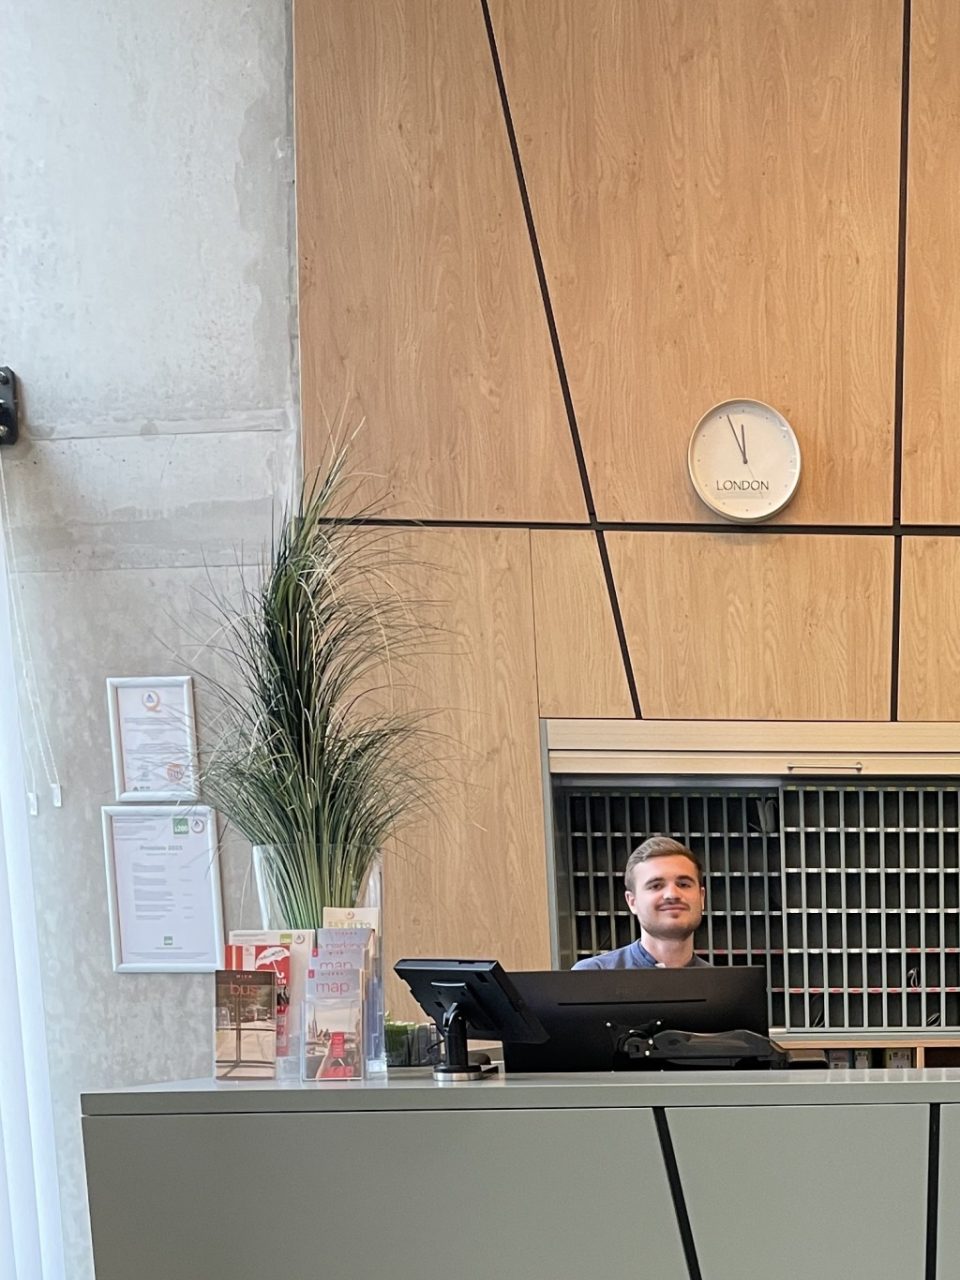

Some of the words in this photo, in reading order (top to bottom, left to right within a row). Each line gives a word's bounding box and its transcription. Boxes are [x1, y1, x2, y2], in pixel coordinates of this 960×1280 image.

[716, 480, 769, 491] LONDON
[230, 981, 257, 995] bus
[316, 982, 350, 996] map
